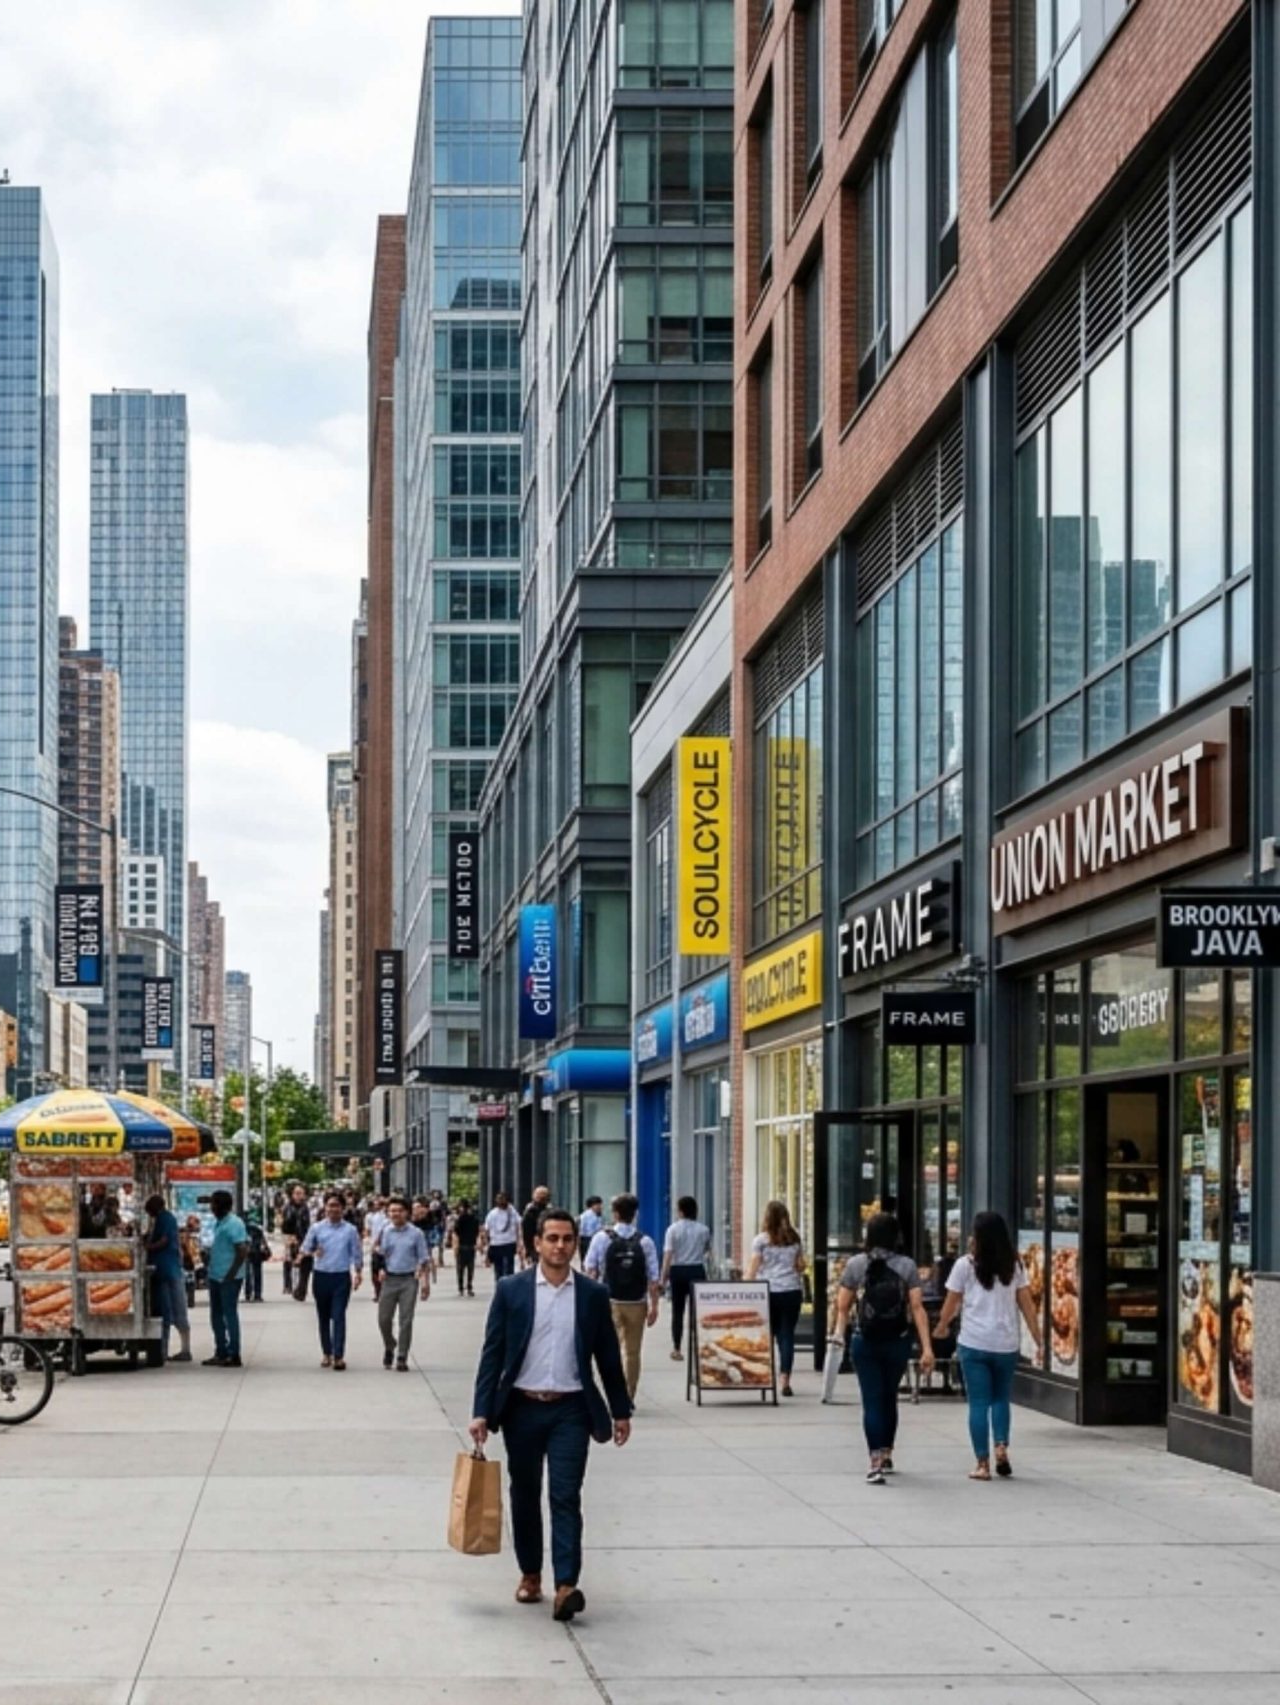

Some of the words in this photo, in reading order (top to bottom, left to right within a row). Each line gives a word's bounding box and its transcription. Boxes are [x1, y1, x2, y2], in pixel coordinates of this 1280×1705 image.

[693, 750, 719, 939] SOULCYCLE
[991, 812, 1066, 912] UNION
[1074, 741, 1204, 879] MARKET
[838, 880, 933, 978] FRAME
[1191, 930, 1264, 956] JAVA
[889, 1011, 966, 1027] FRAME
[24, 1131, 118, 1148] SABRETT
